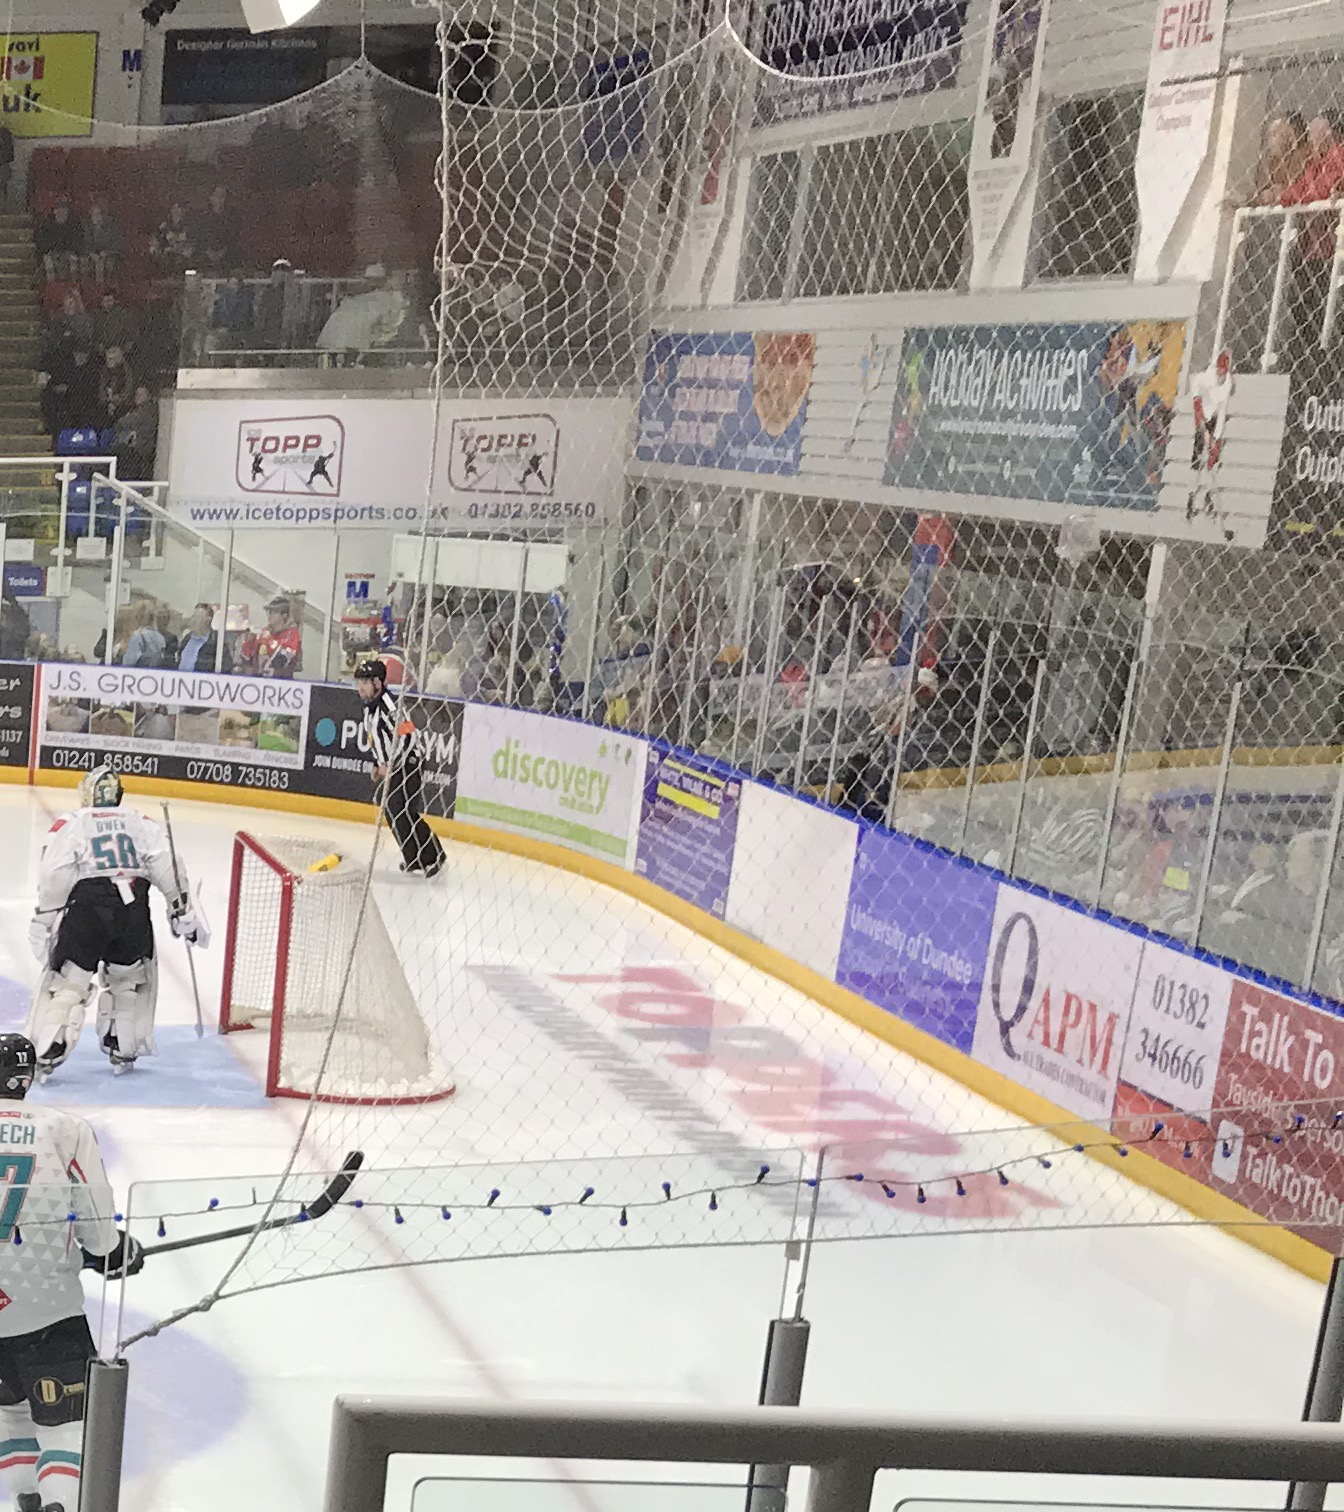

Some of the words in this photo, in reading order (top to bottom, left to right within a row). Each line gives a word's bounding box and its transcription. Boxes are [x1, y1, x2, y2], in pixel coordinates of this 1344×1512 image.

[122, 50, 142, 72] M
[246, 434, 323, 455] TOPP
[7, 576, 39, 589] Toilets
[345, 580, 370, 599] M
[48, 670, 87, 692] J.S.
[97, 672, 305, 711] GROUNDWORKS
[52, 748, 96, 769] 01241
[103, 753, 160, 776] 858541
[186, 760, 232, 783] 07708
[237, 765, 290, 790] 735183
[491, 736, 612, 815] discovery
[907, 932, 923, 961] of
[922, 935, 973, 985] Dundee
[1151, 973, 1210, 1031] 01382
[1134, 1026, 1208, 1090] 346666
[1240, 1001, 1296, 1074] Talk
[1302, 1028, 1335, 1090] To
